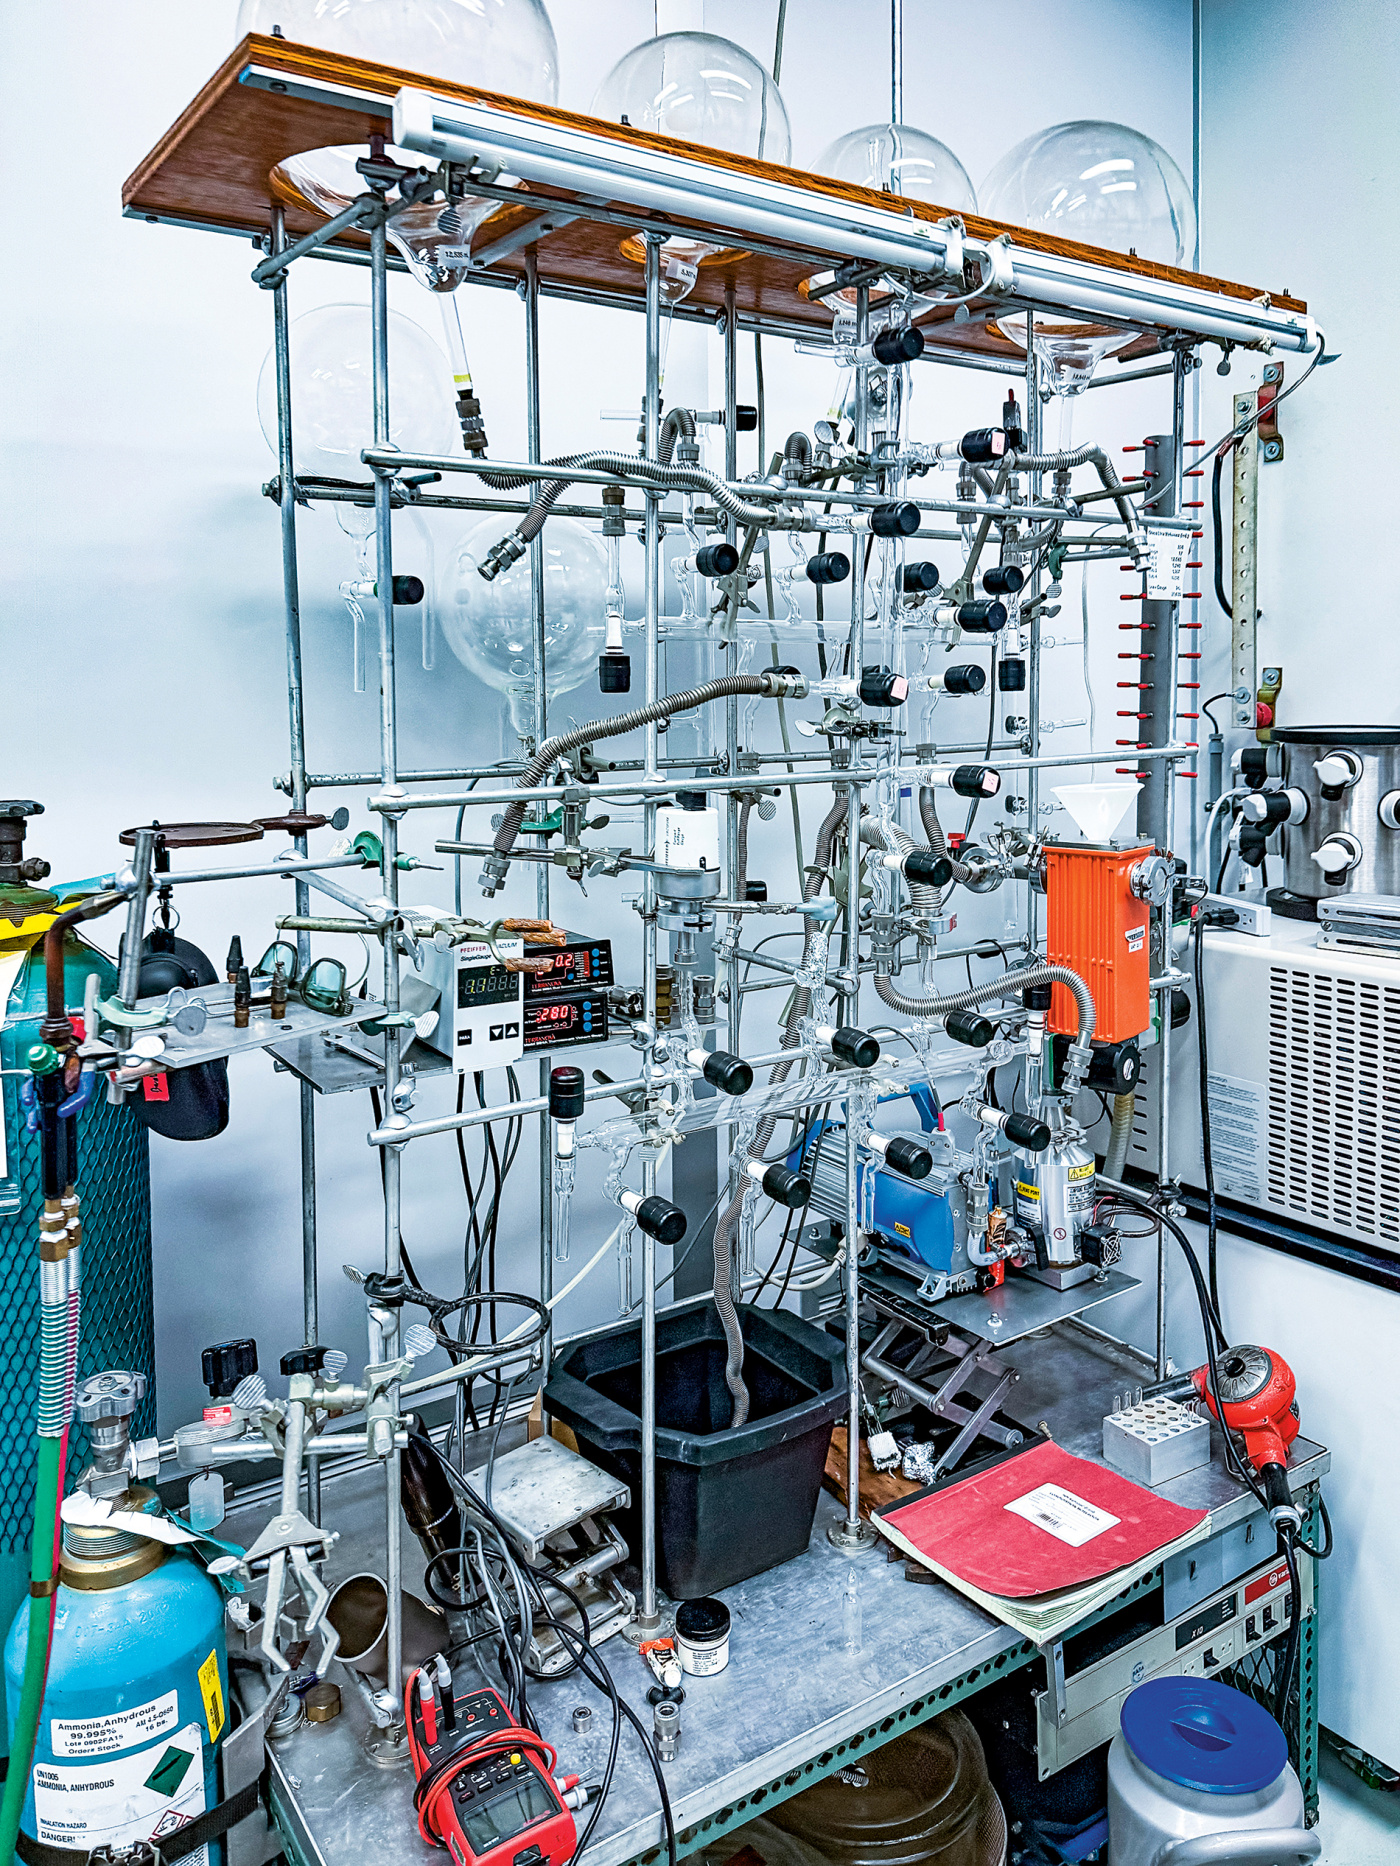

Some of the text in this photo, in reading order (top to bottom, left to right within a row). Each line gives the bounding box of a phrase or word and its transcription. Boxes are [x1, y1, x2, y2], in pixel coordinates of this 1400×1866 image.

[460, 945, 487, 953] PFEIFFER
[460, 954, 492, 962] SingleGauge
[541, 1005, 569, 1021] 280
[58, 1704, 156, 1732] Ammonia,Anhydrous
[70, 1727, 117, 1740] 99.995%
[68, 1743, 121, 1755] Order# Stock
[37, 1768, 59, 1781] UN1005
[37, 1778, 115, 1793] AMMONIA, ANHYDROUS
[66, 1821, 87, 1829] HAZARD
[41, 1832, 76, 1843] DANGER!
